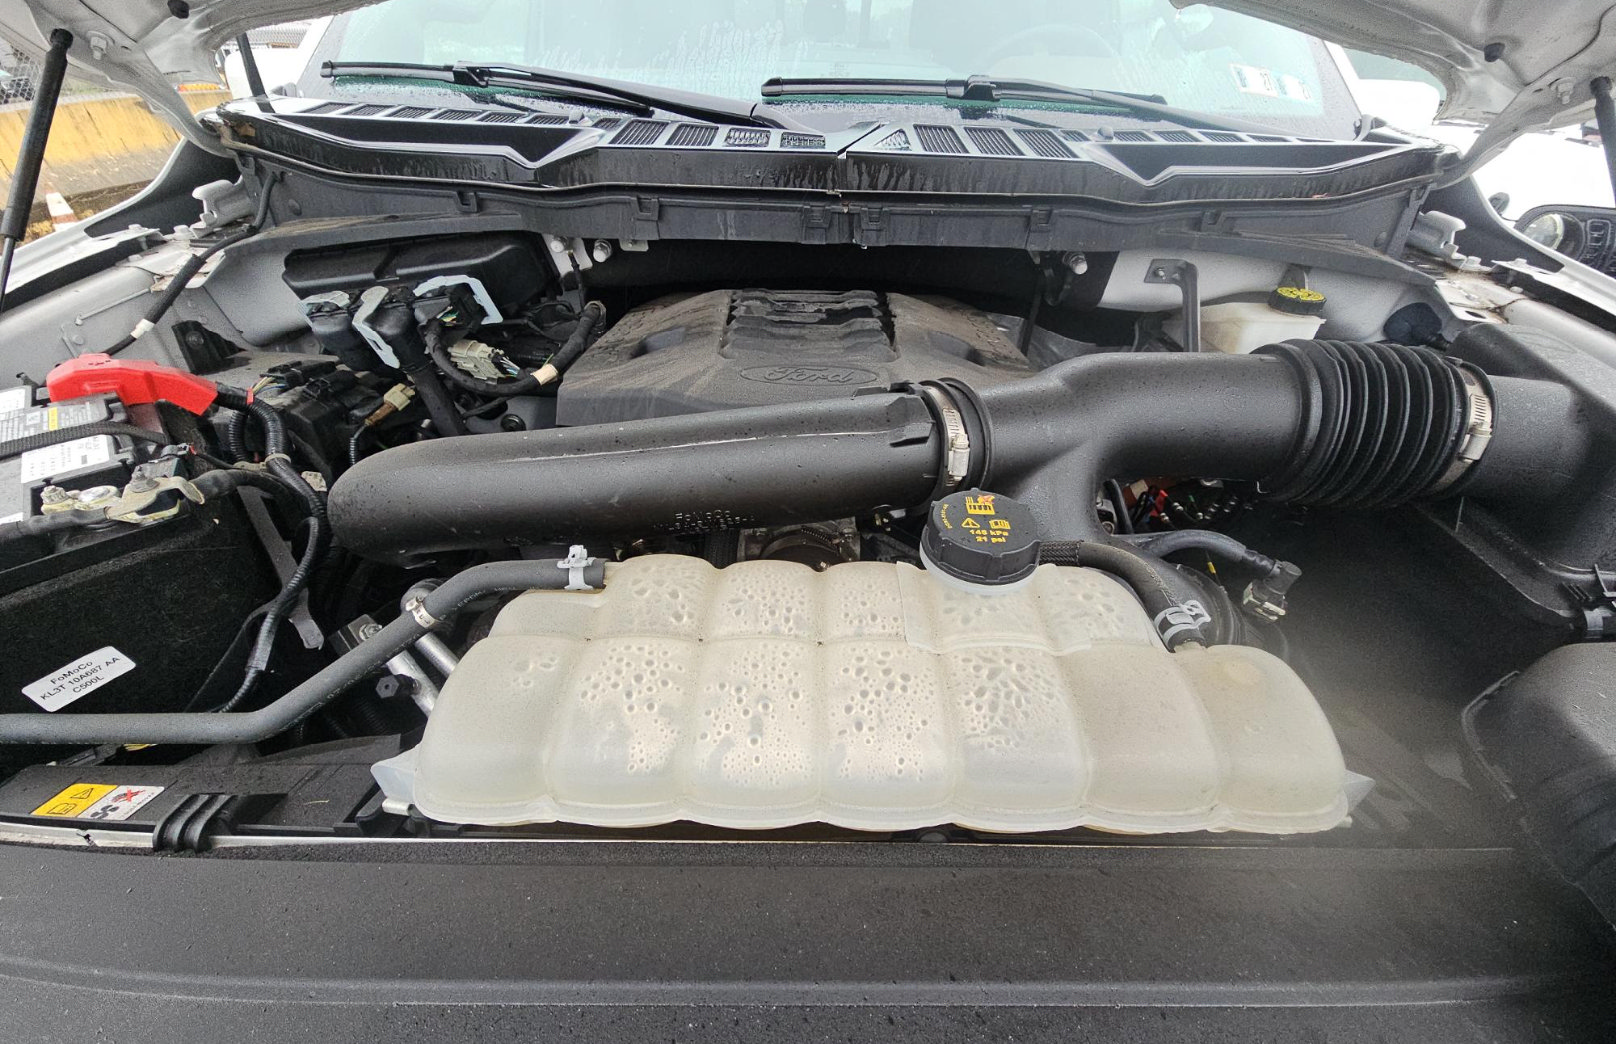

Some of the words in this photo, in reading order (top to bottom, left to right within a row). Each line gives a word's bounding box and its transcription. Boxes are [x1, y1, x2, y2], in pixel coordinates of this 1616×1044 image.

[764, 366, 854, 382] Ford
[40, 684, 67, 701] KL3T
[105, 656, 121, 667] AA
[51, 662, 92, 684] FoMoCo
[72, 675, 104, 694] C500L
